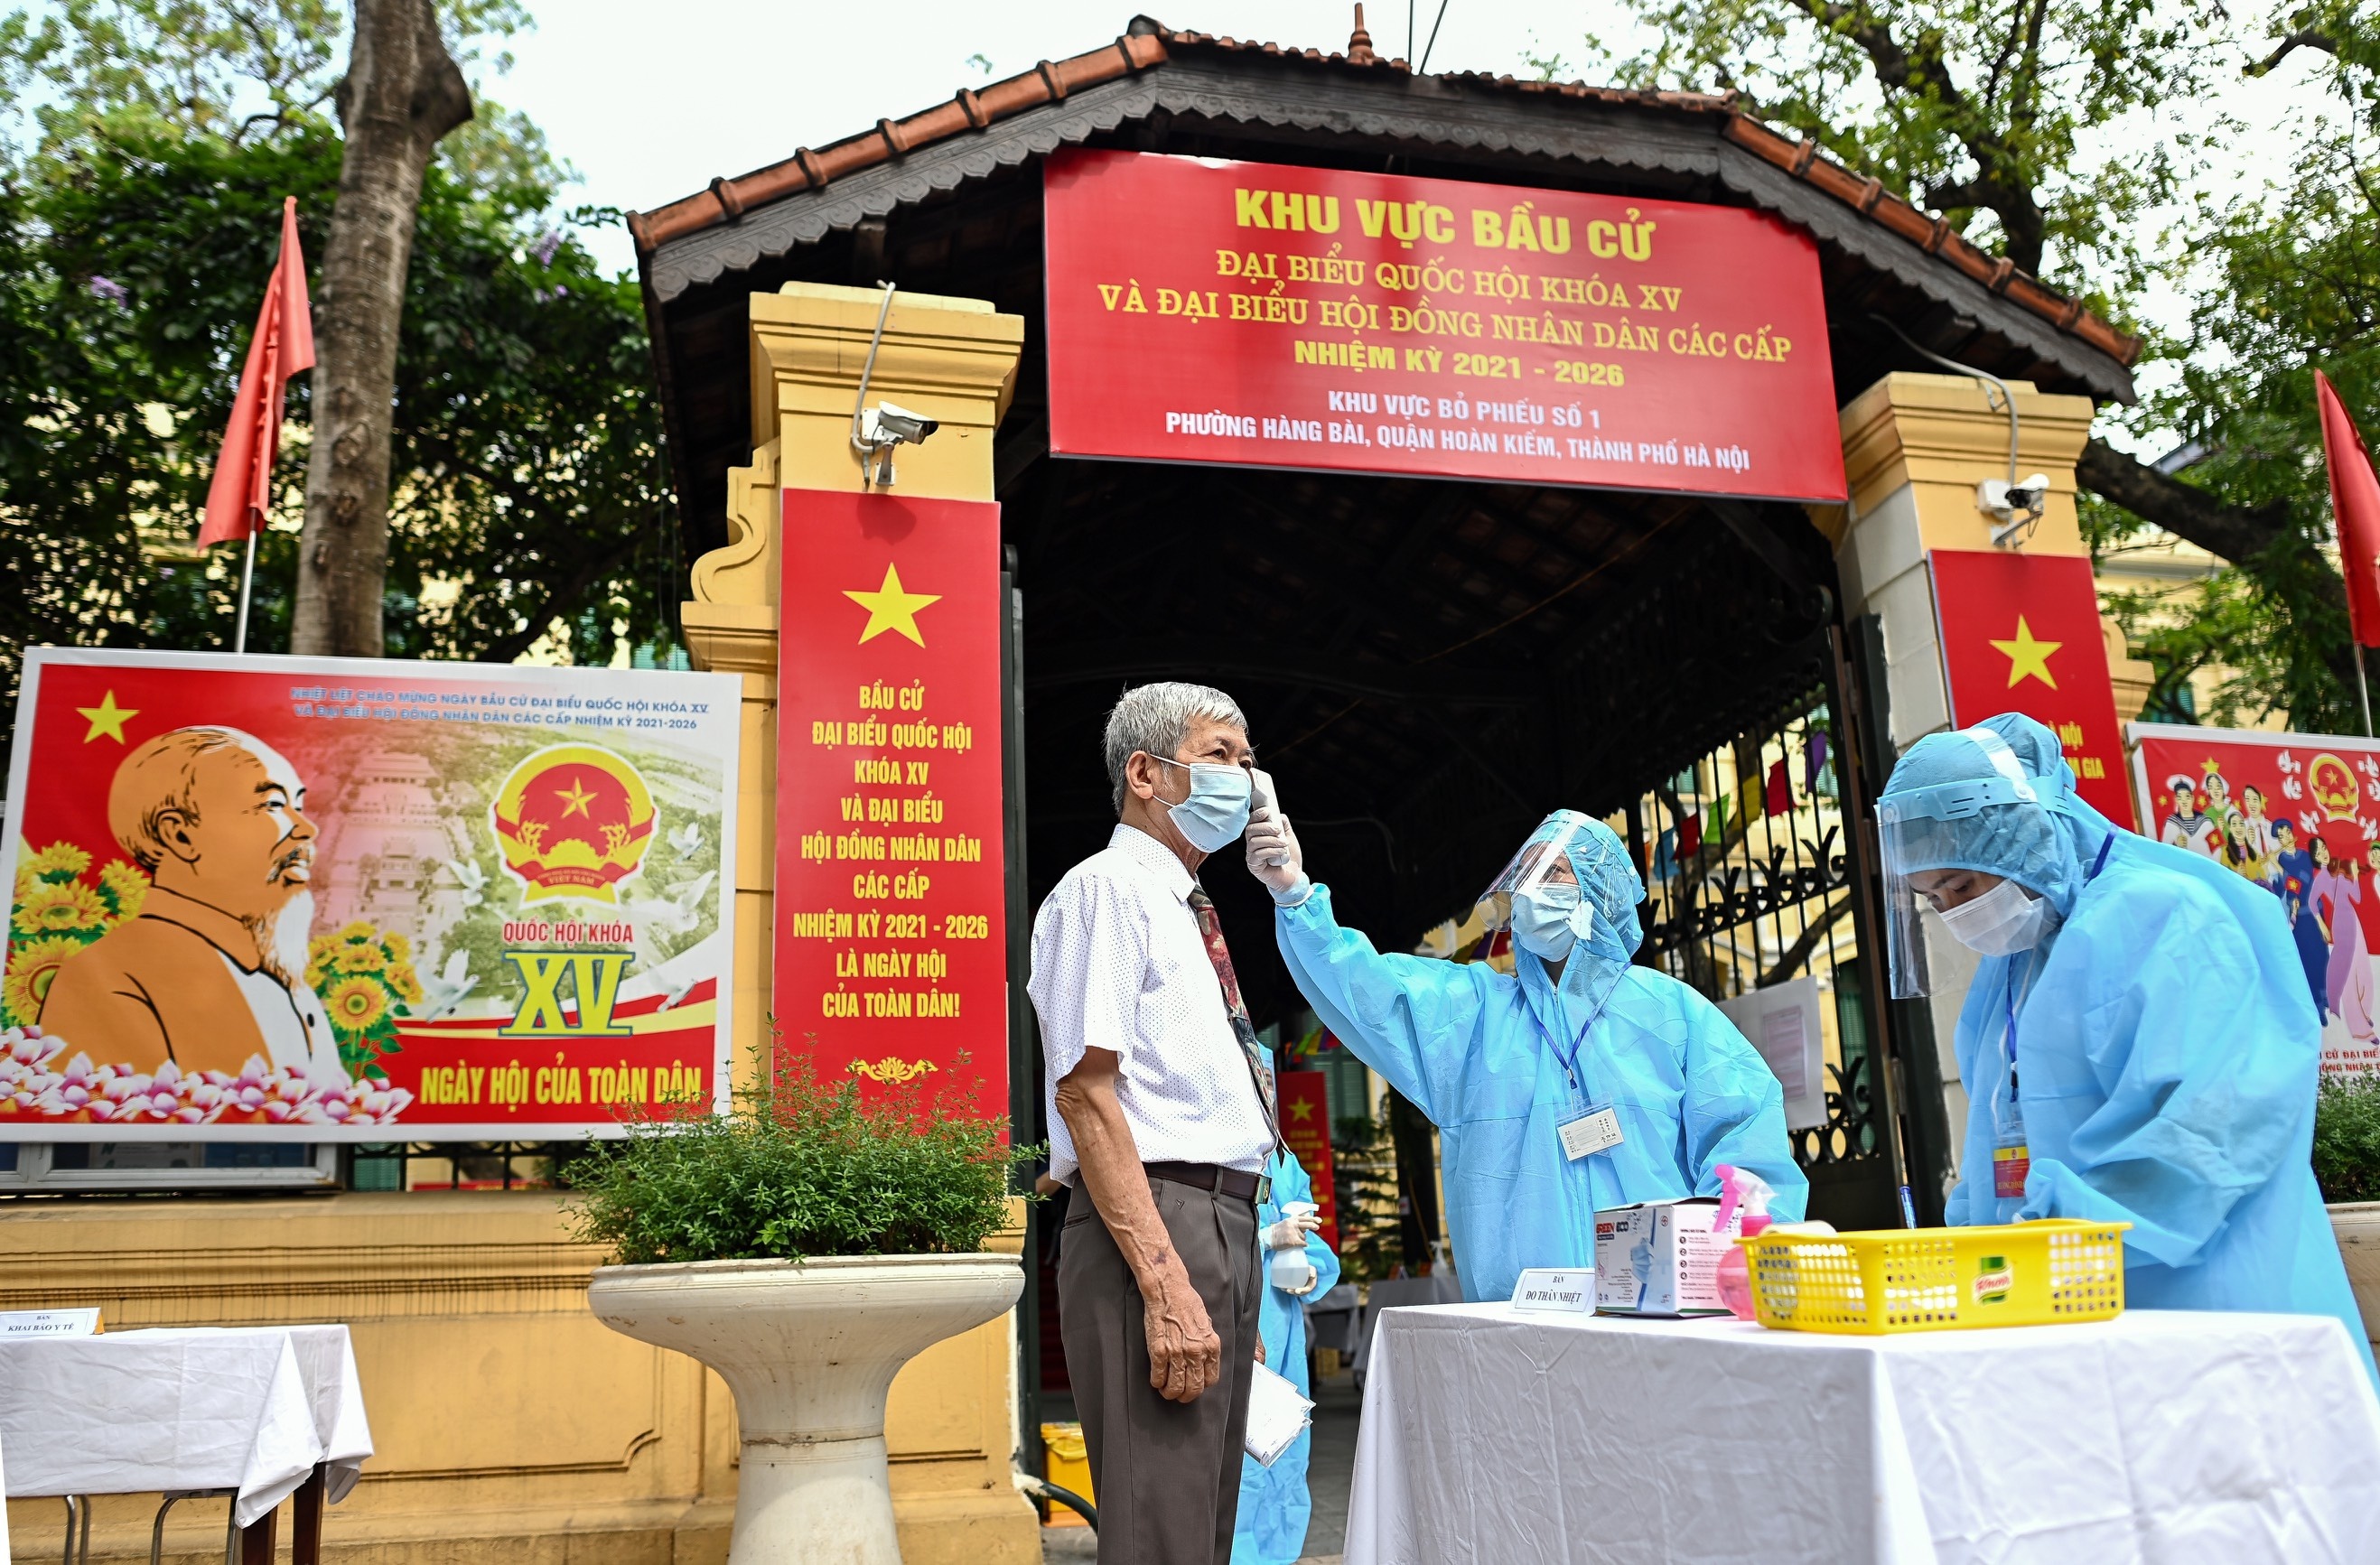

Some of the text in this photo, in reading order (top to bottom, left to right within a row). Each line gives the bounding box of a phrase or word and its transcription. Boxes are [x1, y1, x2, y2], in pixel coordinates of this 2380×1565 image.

[1234, 188, 1657, 262] KHU VỰC BẦU CỬ
[1215, 241, 1682, 312] ĐẠI BIỂU QUỐC HỘI KHÓA XV
[1097, 277, 1792, 362] VÀ ĐẠI BIỂU HỘI ĐỒNG NHÂN DÂN CÁC CẤP
[1293, 340, 1625, 387] NHIỆM KỲ 2021 - 2026
[1328, 390, 1601, 429] KHU VỰC BỎ PHIẾU SỐ 1
[1165, 409, 1750, 474] PHƯỜNG HÀNG BÀI, QUẬN HOÀN KIẾM, THÀNH PHỐ HÀ NỘI
[291, 685, 708, 713] NHIỆT LIỆT CHÀO MỪNG NGÀY BẦU CỬ ĐẠI BIỂU QUỐC HỘI KHÓA XV
[859, 678, 925, 712] BẦU CỬ
[294, 703, 697, 730] VÀ ĐẠI BIỂU HỘI ĐỒNG NHÂN DÂN CÁC CẤP NHIỆM KỲ 2021-2026
[812, 713, 972, 755] ĐẠI BIỂU QUỐC HỘI
[2059, 721, 2084, 751] NỘI
[854, 756, 929, 786] KHÓA XV
[2082, 757, 2105, 779] GIA
[840, 790, 943, 827] VÀ ĐẠI BIỂU
[801, 828, 981, 865] HỘI ĐỒNG NHÂN DÂN
[853, 867, 930, 899] CÁC CẤP
[503, 916, 633, 946] QUỐC HỘI KHÓA
[793, 908, 853, 944] NHIỆM
[857, 908, 881, 938] KỲ
[885, 914, 927, 939] 2021
[945, 915, 989, 939] 2026
[836, 947, 947, 983] LÀ NGÀY HỘI
[498, 950, 636, 1037] XV
[822, 982, 960, 1018] CỦA TOÀN DÂN!
[420, 1051, 702, 1113] NGÀY HỘI CỦA TOÀN DÂN
[1526, 1289, 1582, 1305] ĐO THÂN NHIỆT
